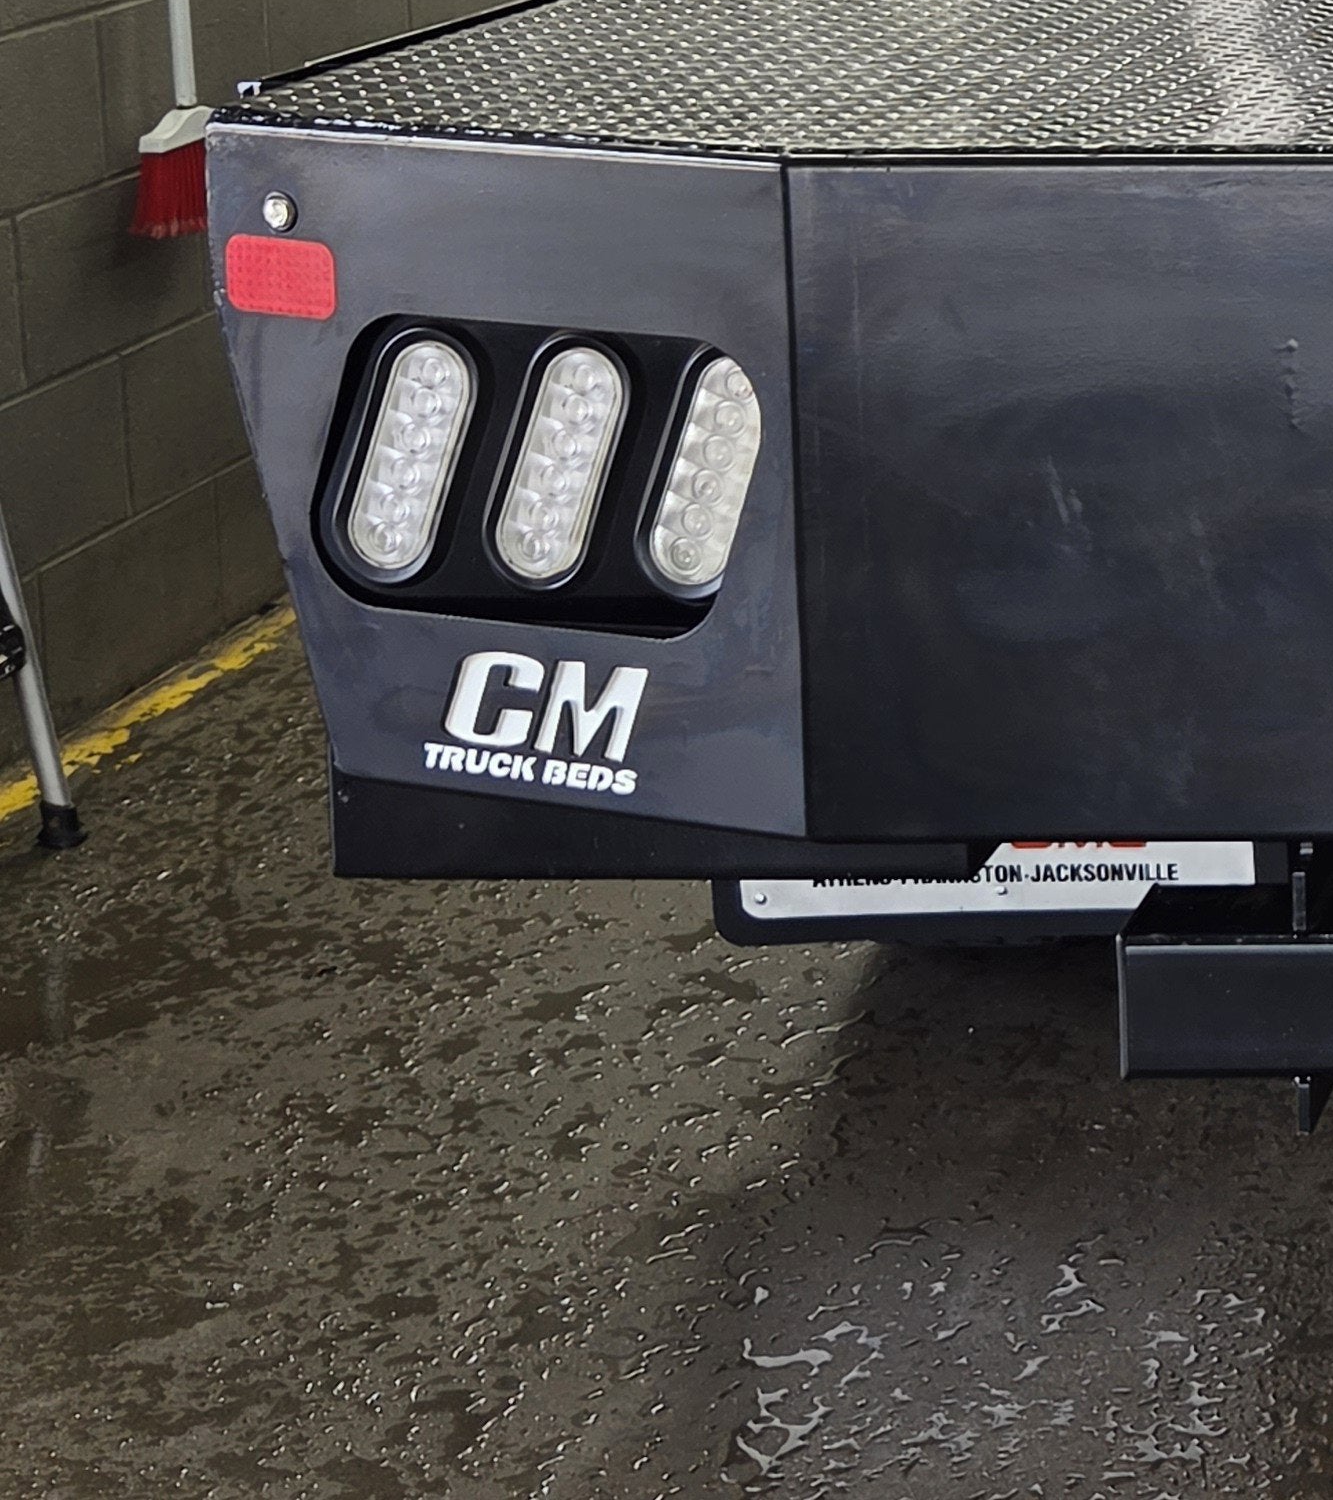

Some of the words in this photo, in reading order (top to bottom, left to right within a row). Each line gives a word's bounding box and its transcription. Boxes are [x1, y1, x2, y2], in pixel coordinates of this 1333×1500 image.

[444, 651, 649, 763] CM
[424, 742, 538, 782] TRUCK
[541, 759, 639, 796] BEDS
